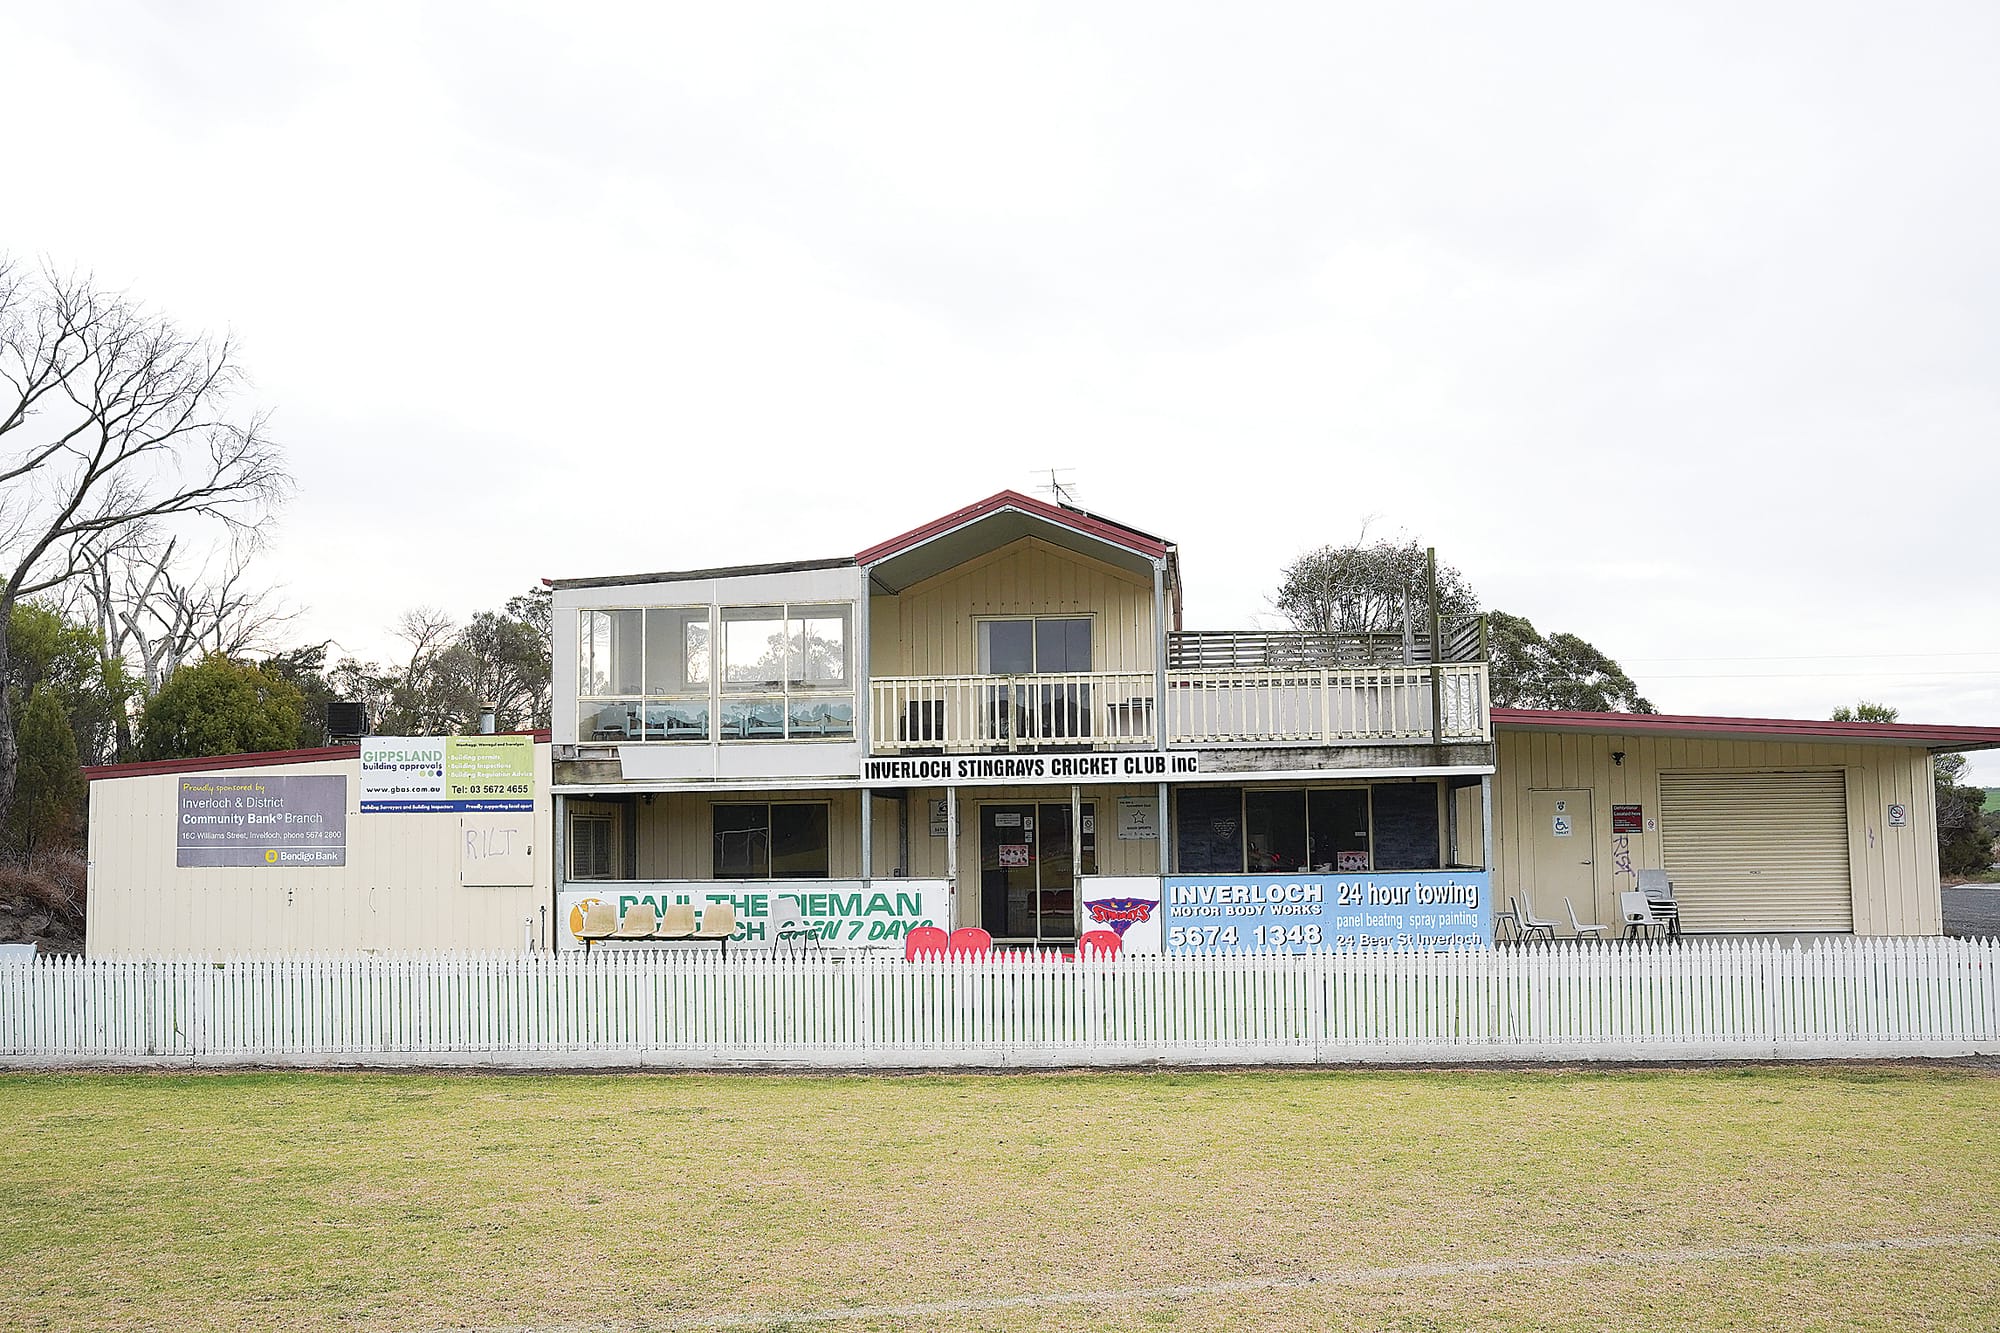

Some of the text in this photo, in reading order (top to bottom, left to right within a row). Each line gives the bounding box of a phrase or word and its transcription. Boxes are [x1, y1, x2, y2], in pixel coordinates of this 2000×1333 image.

[363, 751, 442, 762] GIPPSLAND
[363, 762, 442, 771] building approvals
[865, 756, 1197, 779] INVERLOCH STINGRAYS CRICKET CLUB inc
[183, 783, 265, 795] Proudly sponsored by
[366, 786, 441, 794] www.gbas.com.au
[452, 785, 529, 793] Tel: 03 5672 4655
[183, 797, 284, 809] Inverloch & District
[183, 814, 244, 826] Community
[285, 813, 323, 823] Branch
[284, 832, 304, 841] phone
[281, 851, 338, 862] Bendigo Bank
[1170, 884, 1325, 905] INVERLOCH
[1337, 880, 1479, 908] 24 hour towing
[706, 894, 768, 917] THE
[1171, 905, 1322, 917] MOTOR BODY WORKS
[1336, 911, 1478, 929] panel beating spray painting
[849, 921, 864, 940] 7
[1169, 924, 1323, 946] 5674 1348
[1337, 932, 1482, 946] 24 Bear St Inverloch
